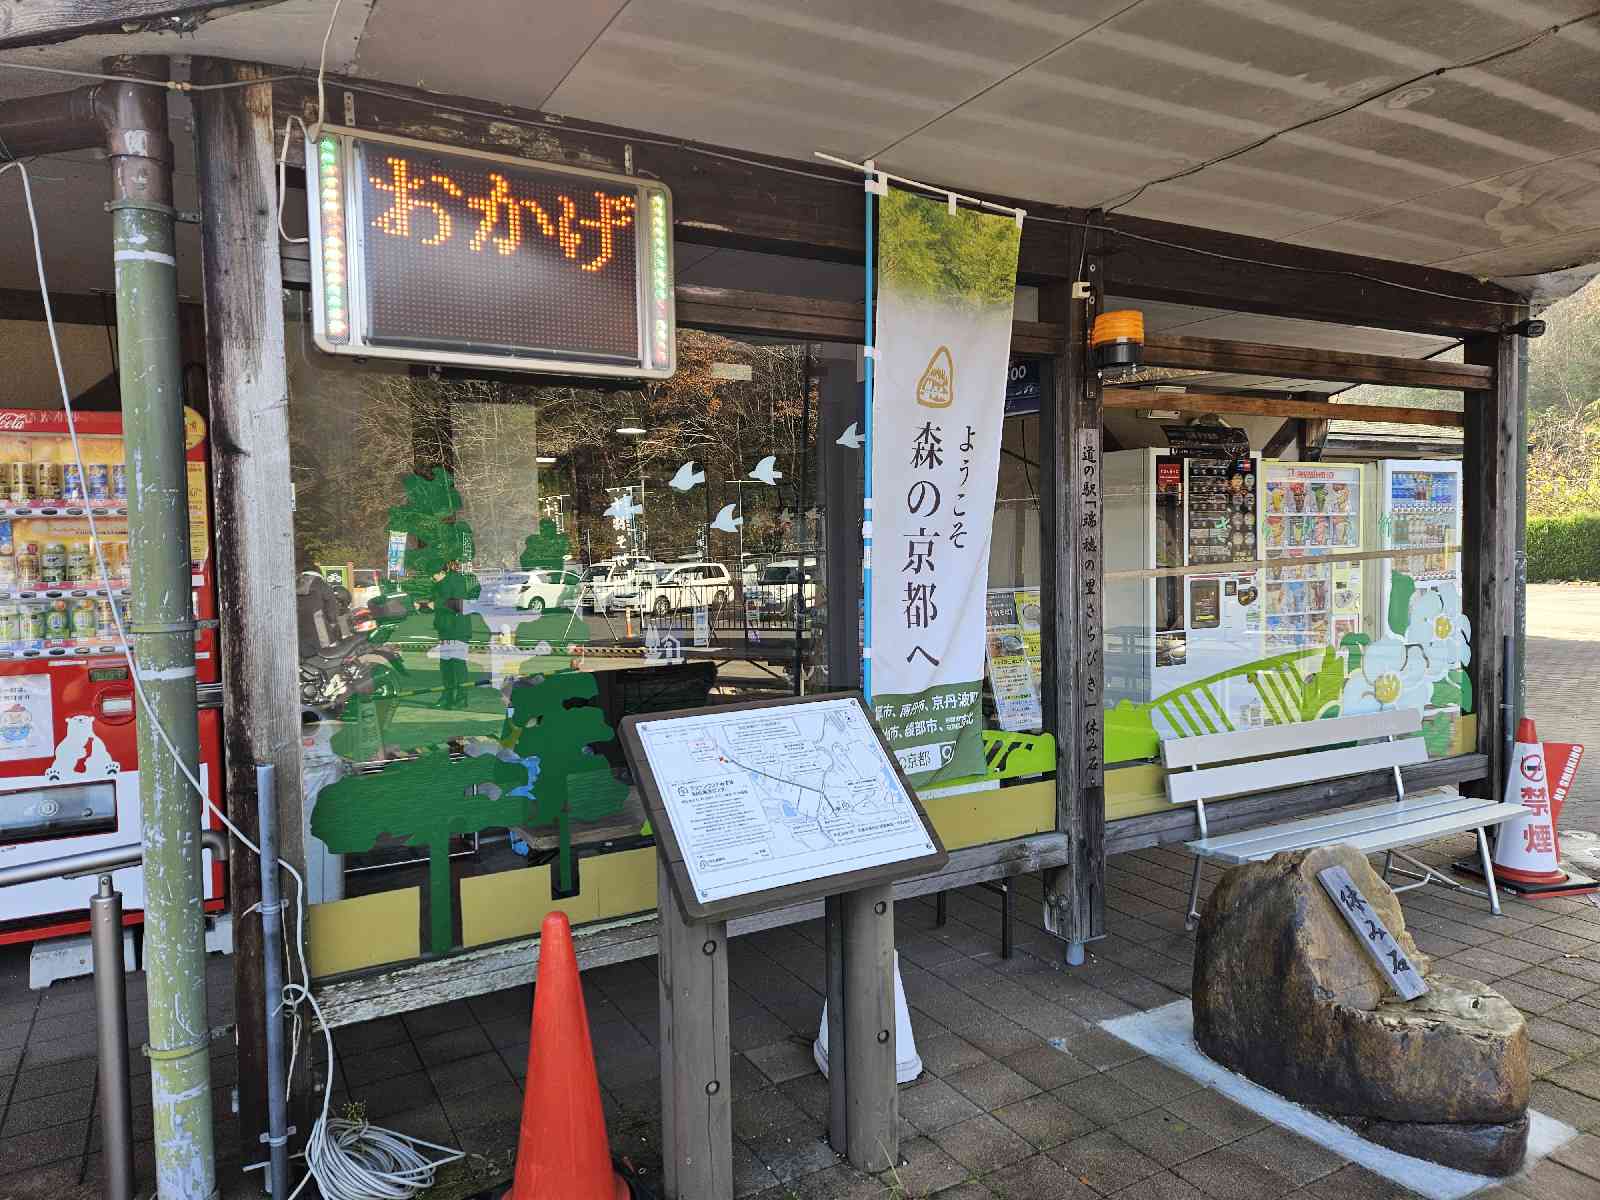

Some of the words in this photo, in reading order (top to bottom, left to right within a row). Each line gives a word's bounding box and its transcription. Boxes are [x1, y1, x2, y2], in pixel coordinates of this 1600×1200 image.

[368, 156, 637, 272] おかげ
[949, 425, 976, 549] ようこそ
[901, 421, 943, 668] 森の京都へ
[1521, 786, 1553, 853] 禁煙
[1552, 788, 1566, 801] NO
[1559, 745, 1583, 787] SMOKING
[1340, 884, 1411, 975] 休み石
